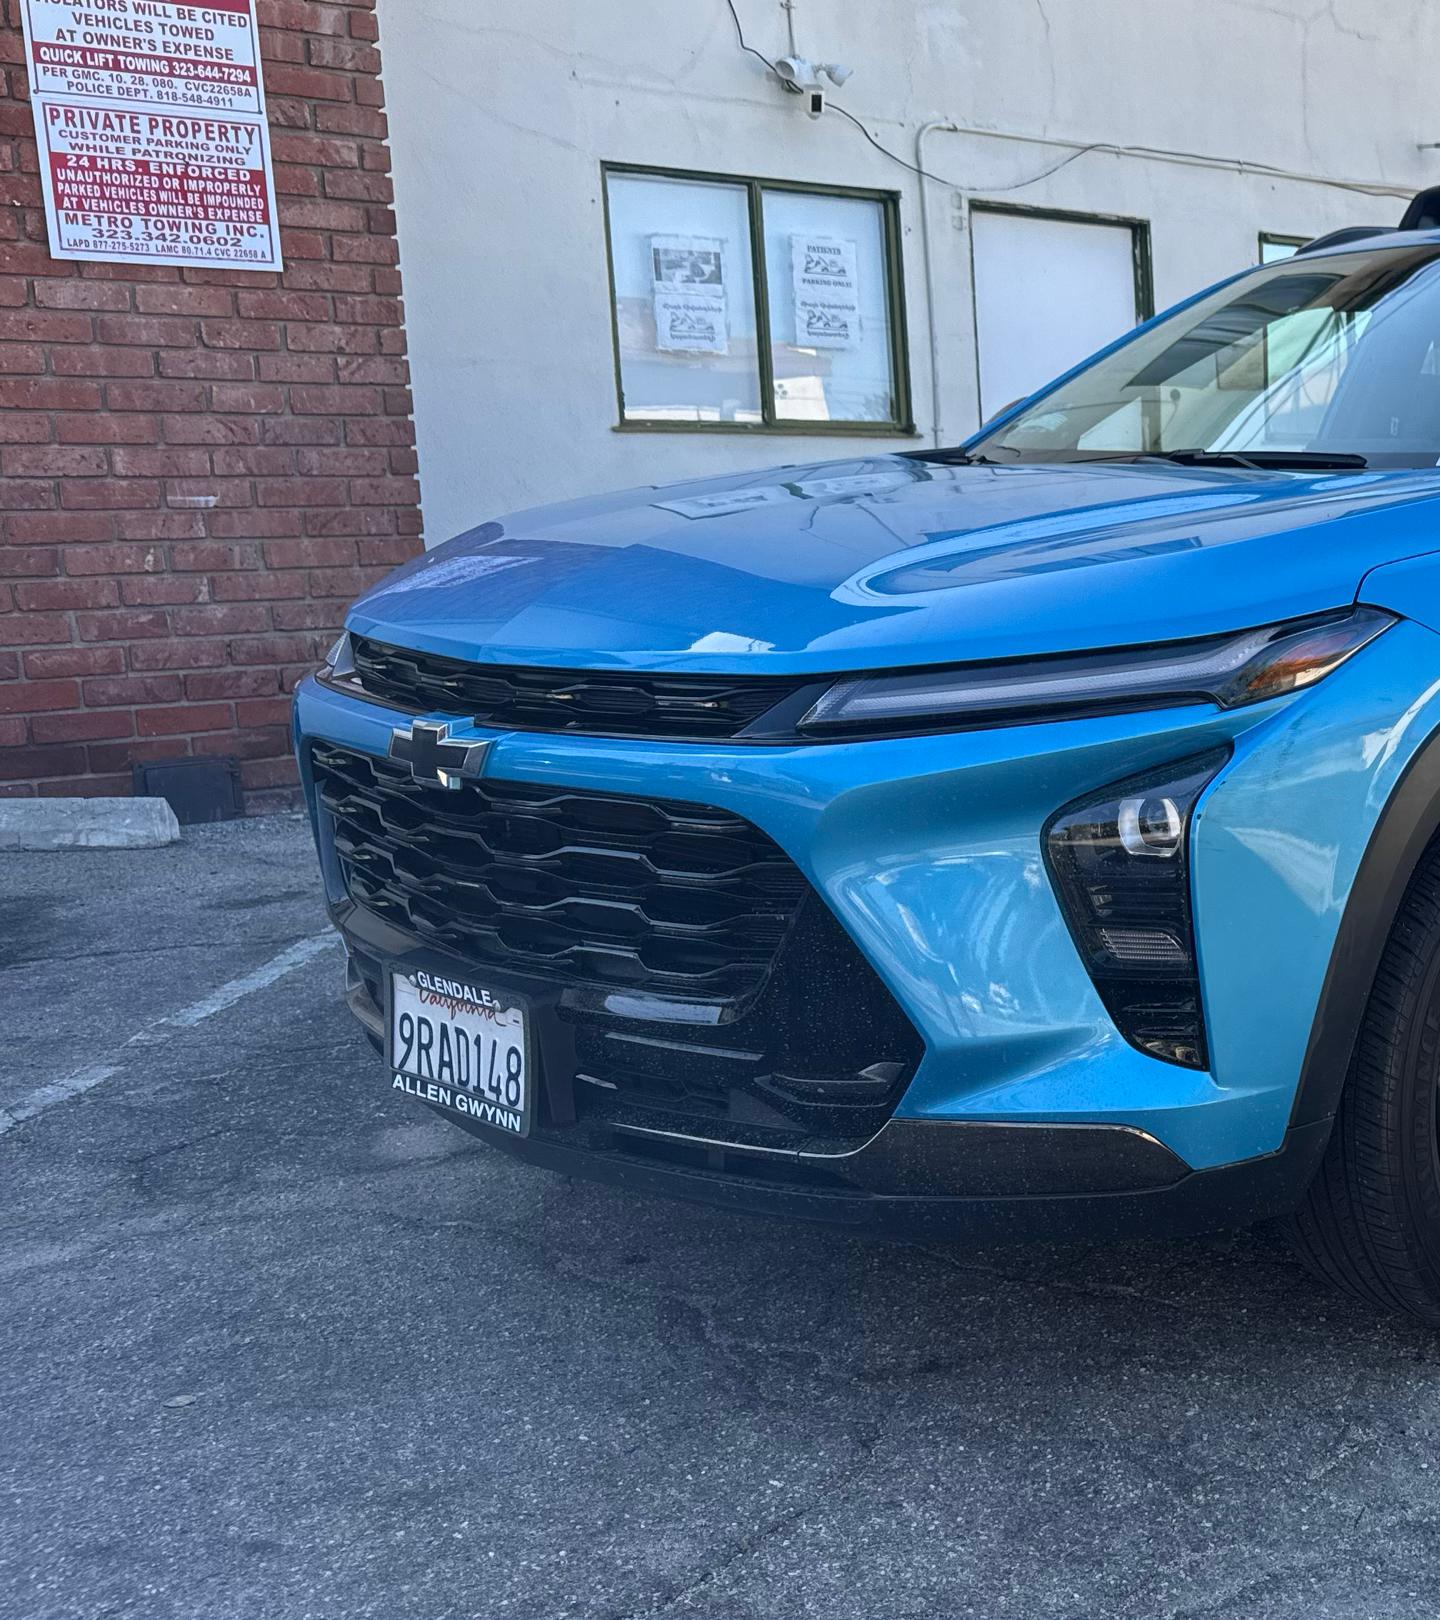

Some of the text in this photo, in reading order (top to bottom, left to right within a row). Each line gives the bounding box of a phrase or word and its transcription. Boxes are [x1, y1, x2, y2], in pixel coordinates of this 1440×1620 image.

[35, 0, 247, 28] ATORS WILL BE CITED
[72, 12, 214, 41] VEHICLES TOWED
[56, 28, 234, 61] AT OWNER'S EXPENSE
[40, 46, 252, 83] QUICK LIFT TOWING 323-644-7294
[42, 66, 252, 98] PER GMC. 10. 28. 080. CVC22658A
[67, 80, 233, 107] POLICE DEPT. 818-548-4911
[49, 107, 255, 145] PRIVATE PROPERTY
[58, 129, 252, 155] CUSTOMER PARKING ONLY
[68, 142, 246, 166] WHILE PATRONIZING
[66, 154, 251, 181] 24 HRS. ENFORCED
[56, 168, 261, 196] UNAUTHORIZED OR IMPROPERLY
[57, 181, 265, 210] PARKED VEHICLES WILL BE IMPOUNDED
[62, 196, 79, 209] AT
[81, 198, 145, 214] VEHICLES
[207, 207, 264, 223] EXPENSE
[64, 212, 265, 239] METRO TOWING INC.
[91, 228, 243, 248] 323.342.0602
[67, 238, 90, 248] LAPD
[93, 240, 150, 252] 877-275-5273
[155, 244, 179, 254] LAMC
[214, 247, 232, 257] CVC
[260, 251, 267, 259] A
[417, 971, 493, 1007] GLENDALE
[399, 1012, 522, 1107] 9RAD148
[392, 1074, 521, 1132] ALLEN GWYNN
